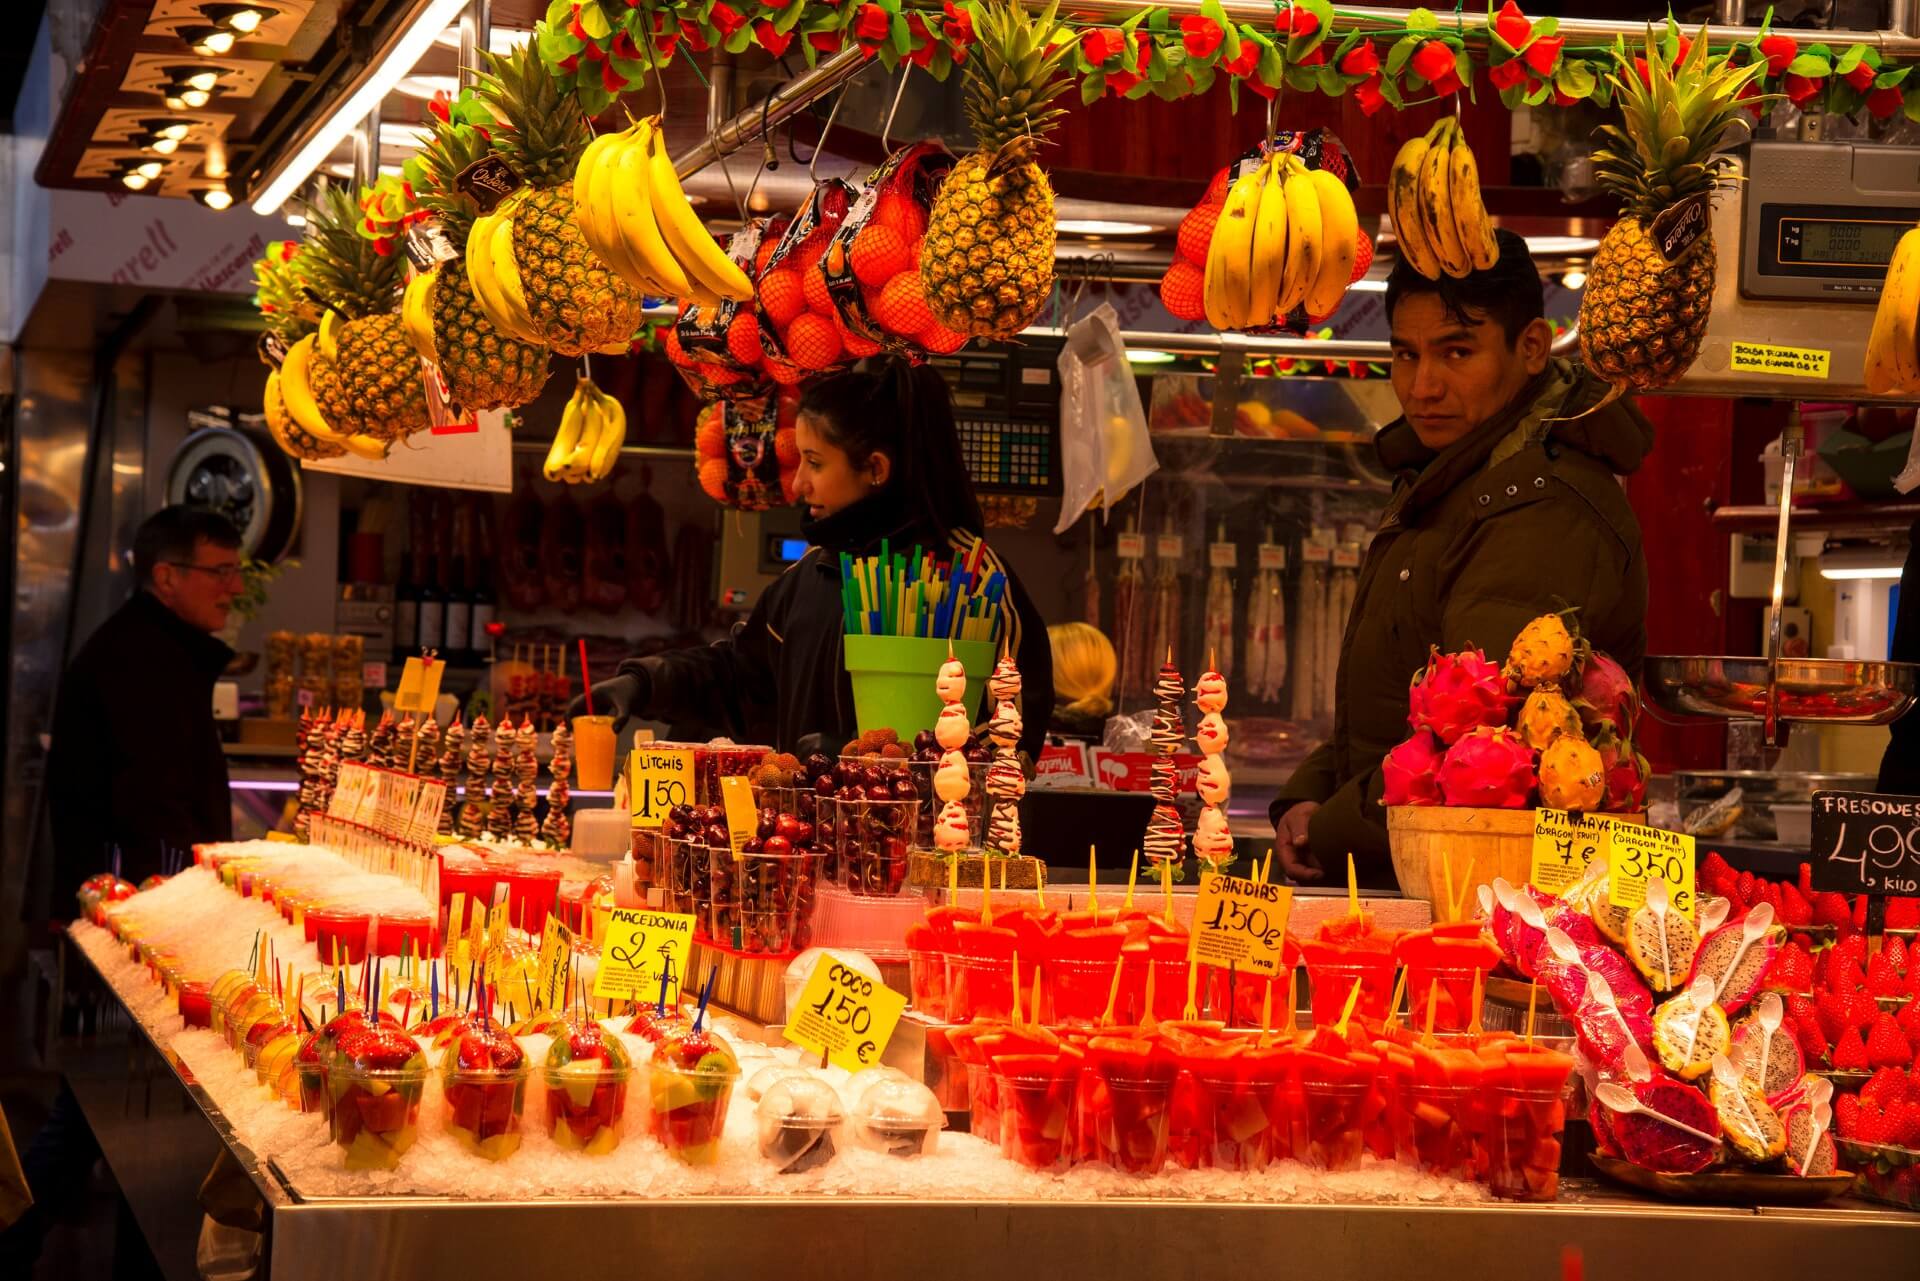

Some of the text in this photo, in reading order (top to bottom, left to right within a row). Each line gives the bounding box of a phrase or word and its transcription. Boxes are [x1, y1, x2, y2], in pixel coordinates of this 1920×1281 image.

[472, 168, 512, 192] Orsero
[1665, 203, 1701, 252] Orsero
[1735, 345, 1764, 356] BOLSA
[1735, 356, 1762, 366] BOLSA
[1613, 822, 1680, 846] PITAHAYA
[1555, 840, 1573, 864] 7
[1209, 876, 1278, 902] SANDIAS
[1674, 891, 1689, 911] €
[612, 910, 688, 932] MACEDONIA
[611, 931, 647, 969] 2
[829, 964, 872, 997] COCO
